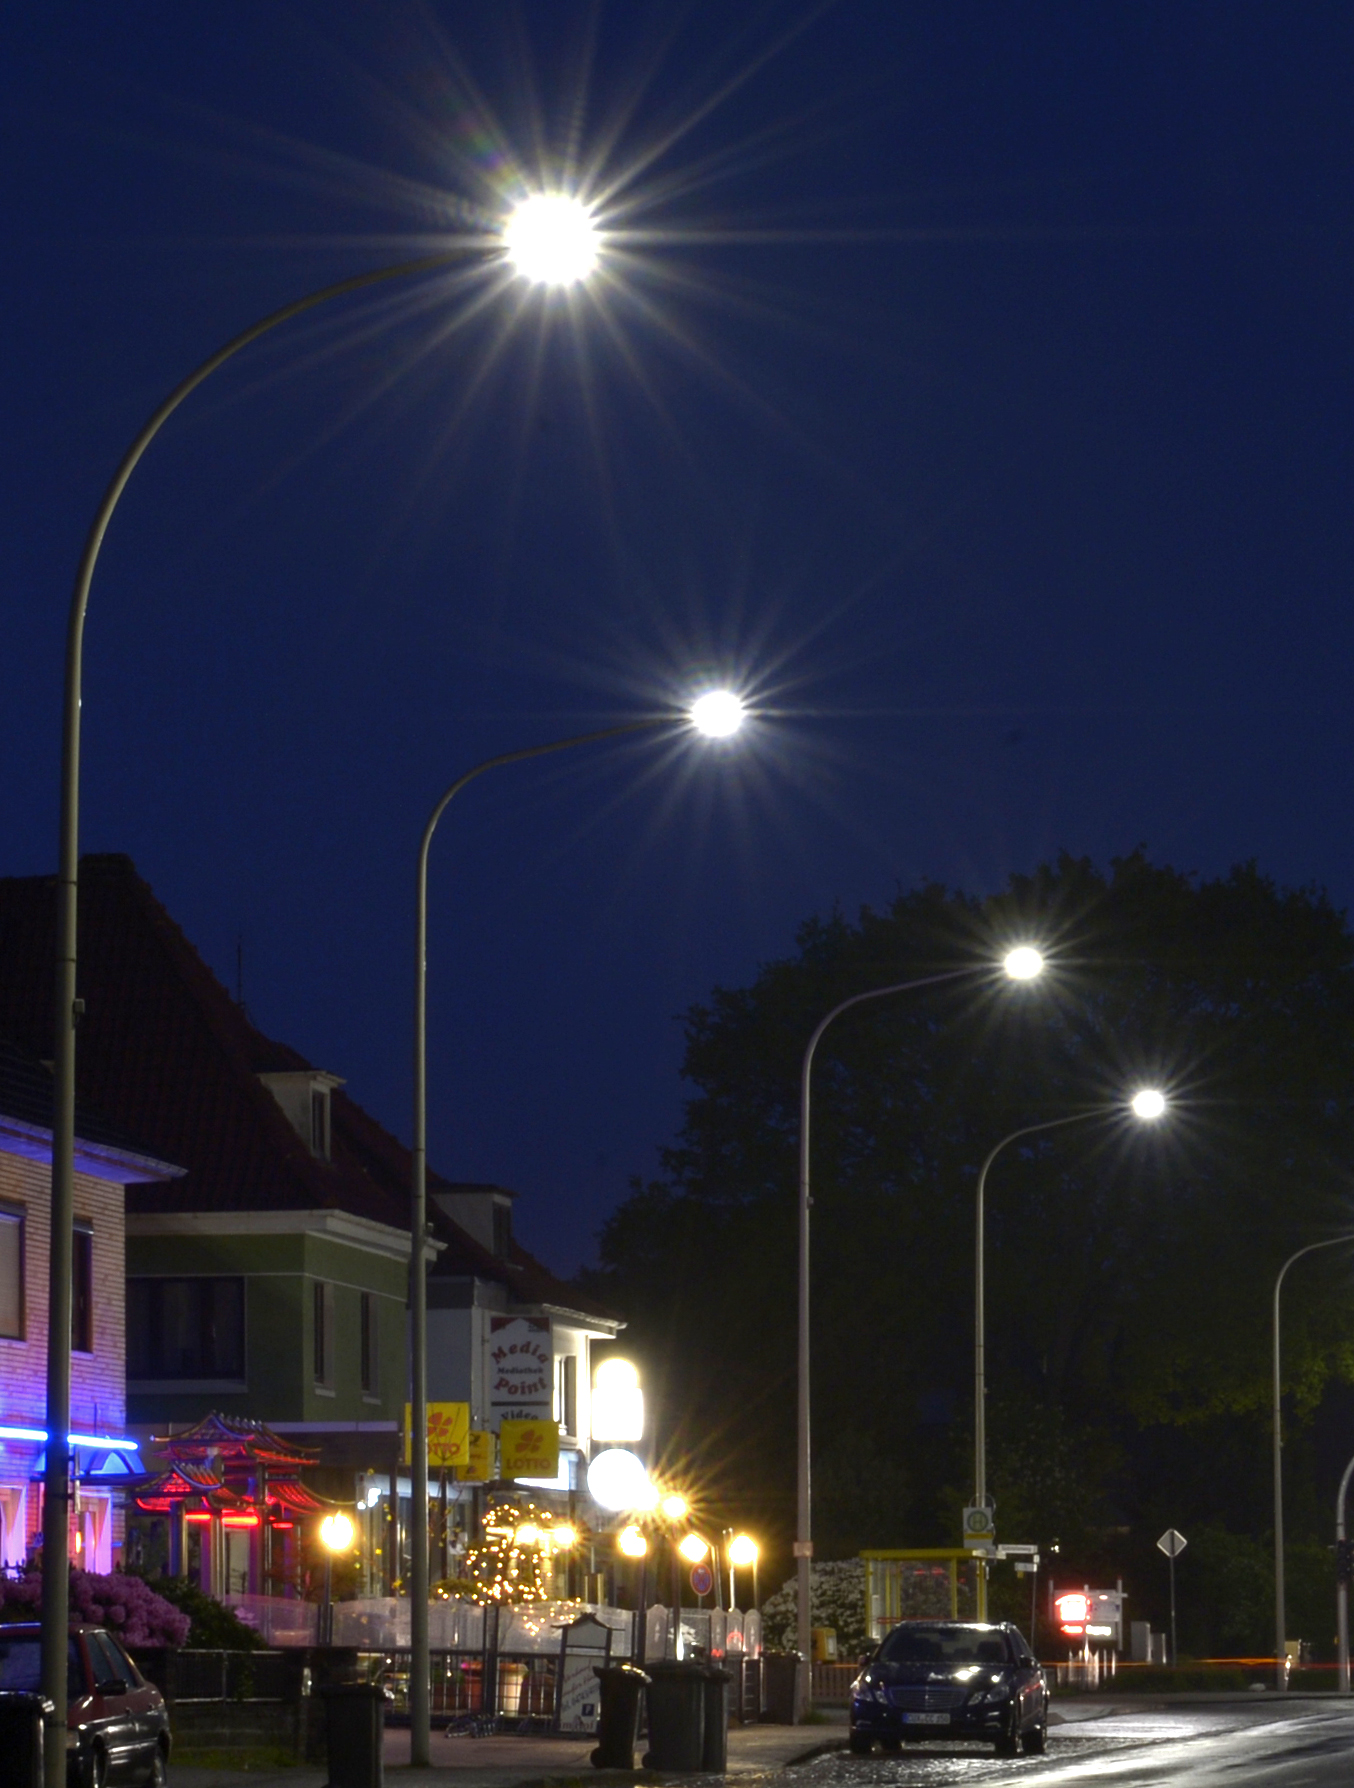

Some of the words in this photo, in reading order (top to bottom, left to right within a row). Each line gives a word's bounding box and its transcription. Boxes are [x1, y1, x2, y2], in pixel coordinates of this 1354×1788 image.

[491, 1341, 549, 1364] Media
[494, 1377, 547, 1395] Point
[501, 1410, 539, 1420] Video
[506, 1459, 552, 1470] LOTTO
